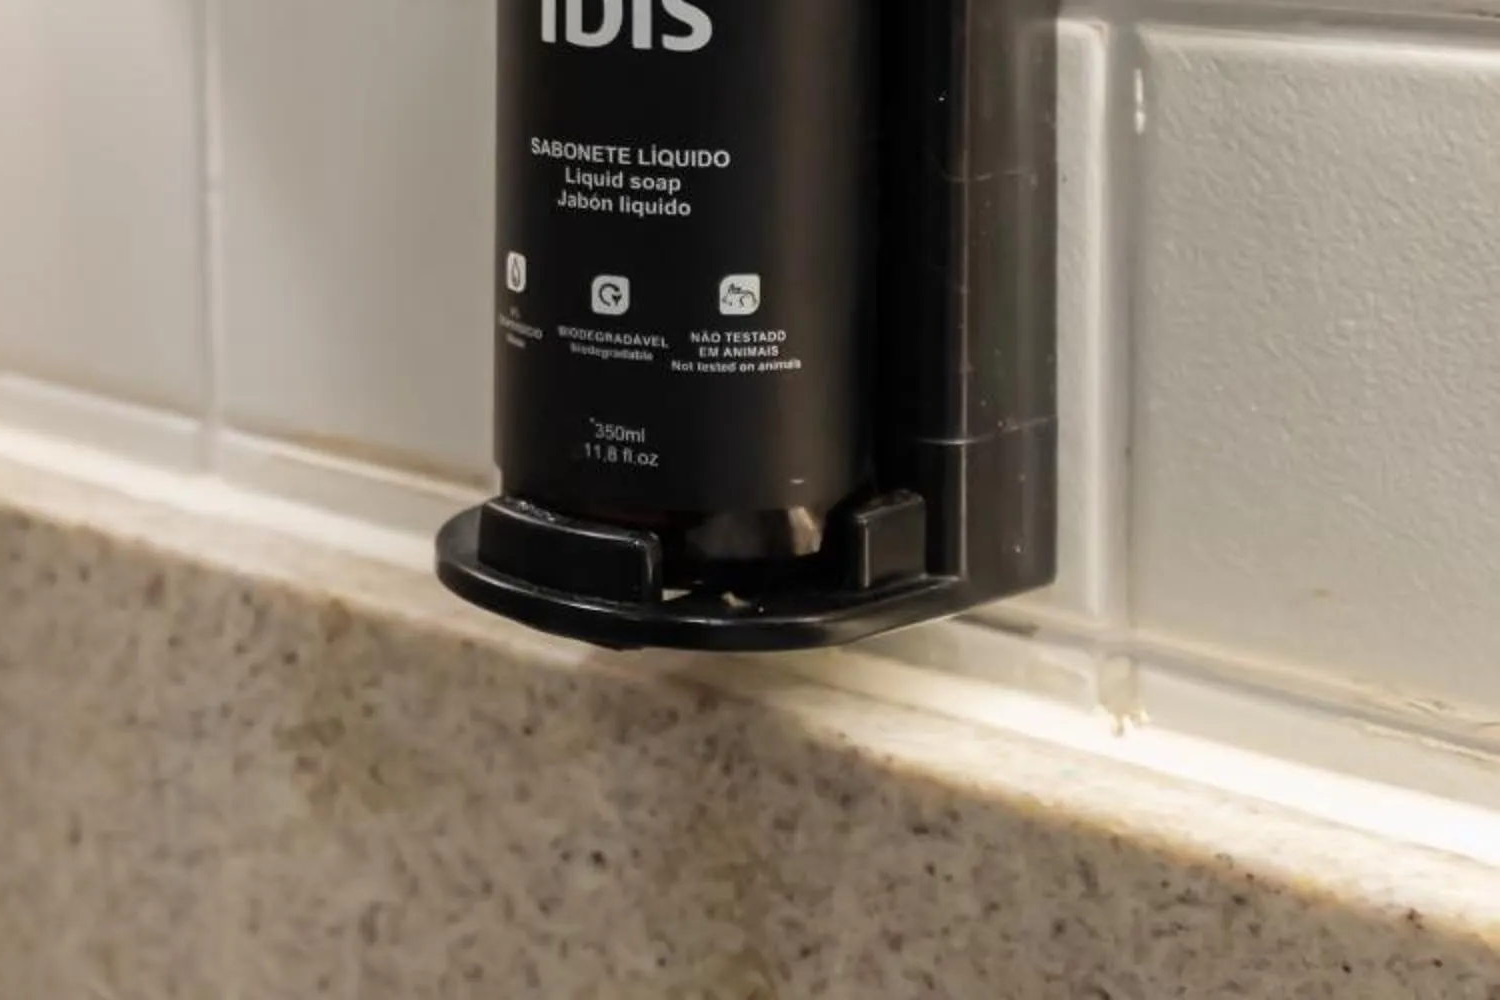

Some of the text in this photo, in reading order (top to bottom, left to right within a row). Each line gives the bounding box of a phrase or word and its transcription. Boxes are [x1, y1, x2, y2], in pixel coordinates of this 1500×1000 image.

[531, 137, 631, 165] SABONETE
[564, 166, 681, 195] Liquid soap
[557, 189, 613, 212] Jabón
[723, 329, 787, 343] TESTADO
[698, 345, 780, 358] EM ANIMAIS
[671, 359, 694, 372] Not
[697, 360, 737, 373] tested
[739, 362, 755, 372] on
[595, 422, 646, 444] 350ml
